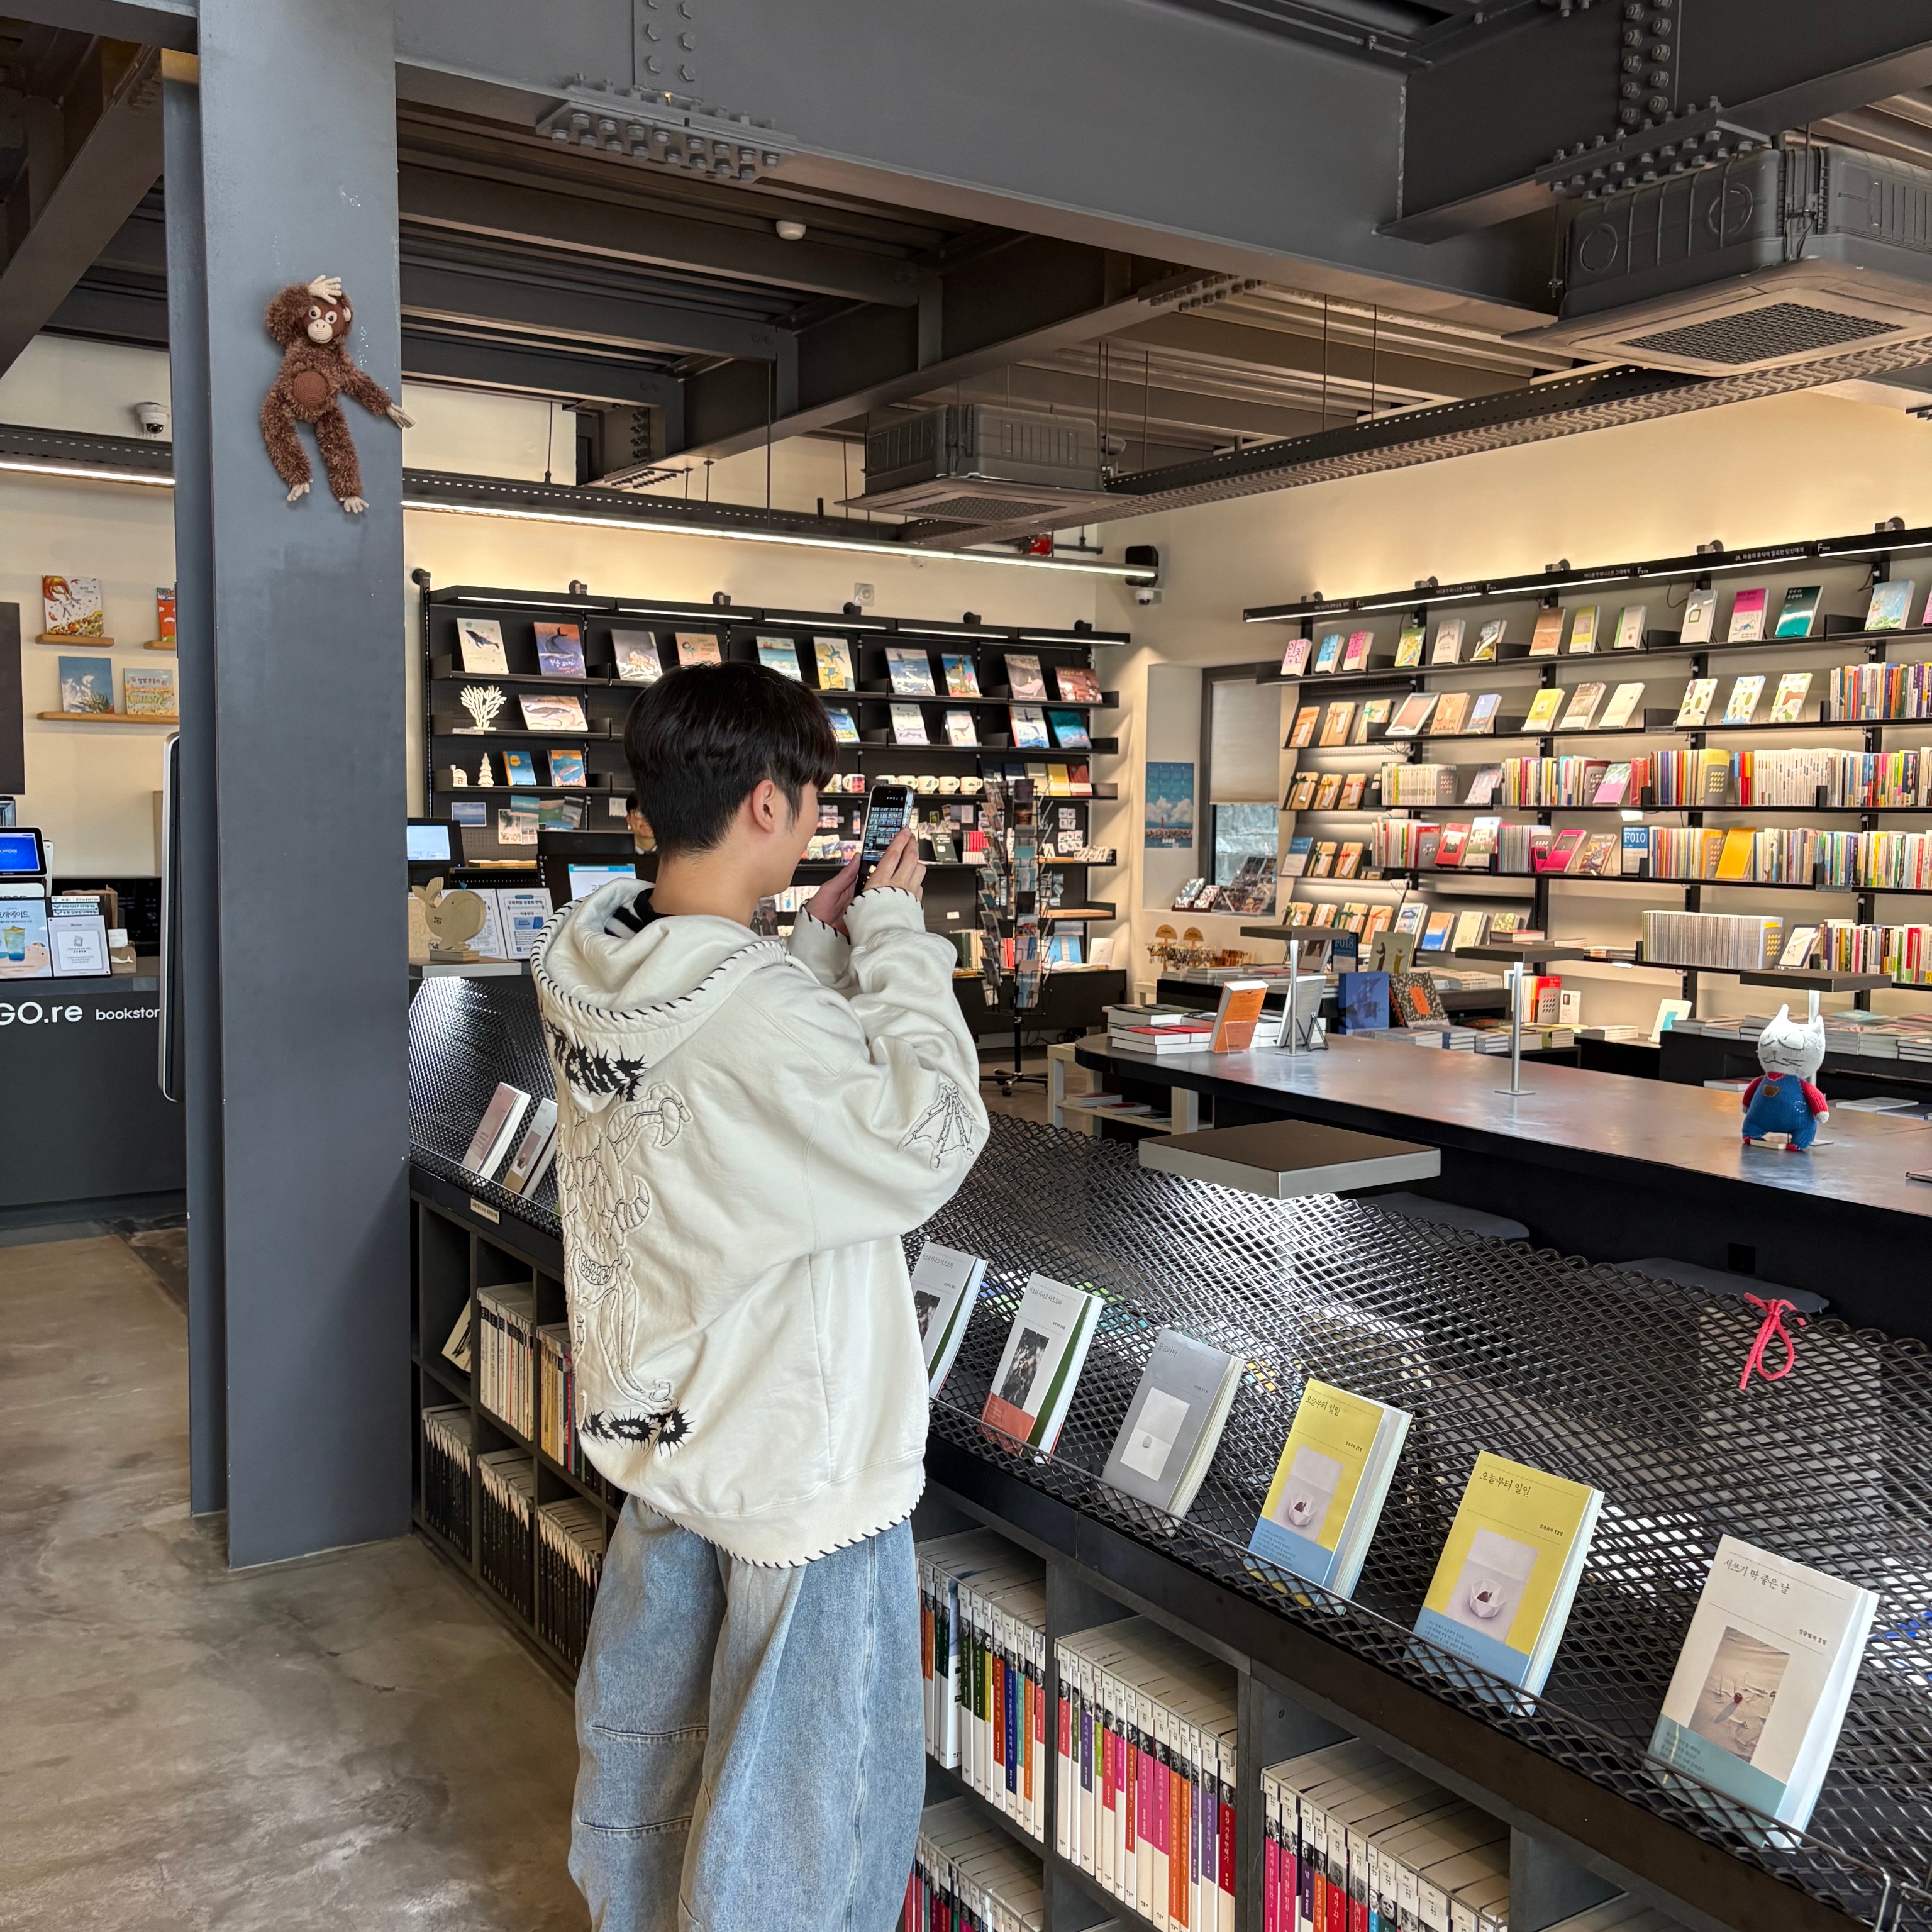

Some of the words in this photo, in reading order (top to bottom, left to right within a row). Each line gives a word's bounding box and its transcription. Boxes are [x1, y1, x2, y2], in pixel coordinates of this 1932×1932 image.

[1288, 640, 1305, 663] 인천
[1624, 832, 1646, 843] F010
[1335, 938, 1353, 948] F018
[96, 1008, 159, 1021] bookstor
[1158, 1343, 1178, 1357] 물끄러미
[1305, 1394, 1327, 1411] 오늘부터
[1328, 1403, 1341, 1416] 일일
[1479, 1470, 1513, 1491] 오늘부터
[1514, 1482, 1531, 1497] 일일
[1723, 1559, 1746, 1577] 시쓰기
[1750, 1569, 1760, 1581] 딱
[1760, 1574, 1779, 1589] 좋은
[1781, 1582, 1790, 1594] 날
[1269, 1884, 1274, 1899] 인간
[1285, 1897, 1289, 1912] 인간
